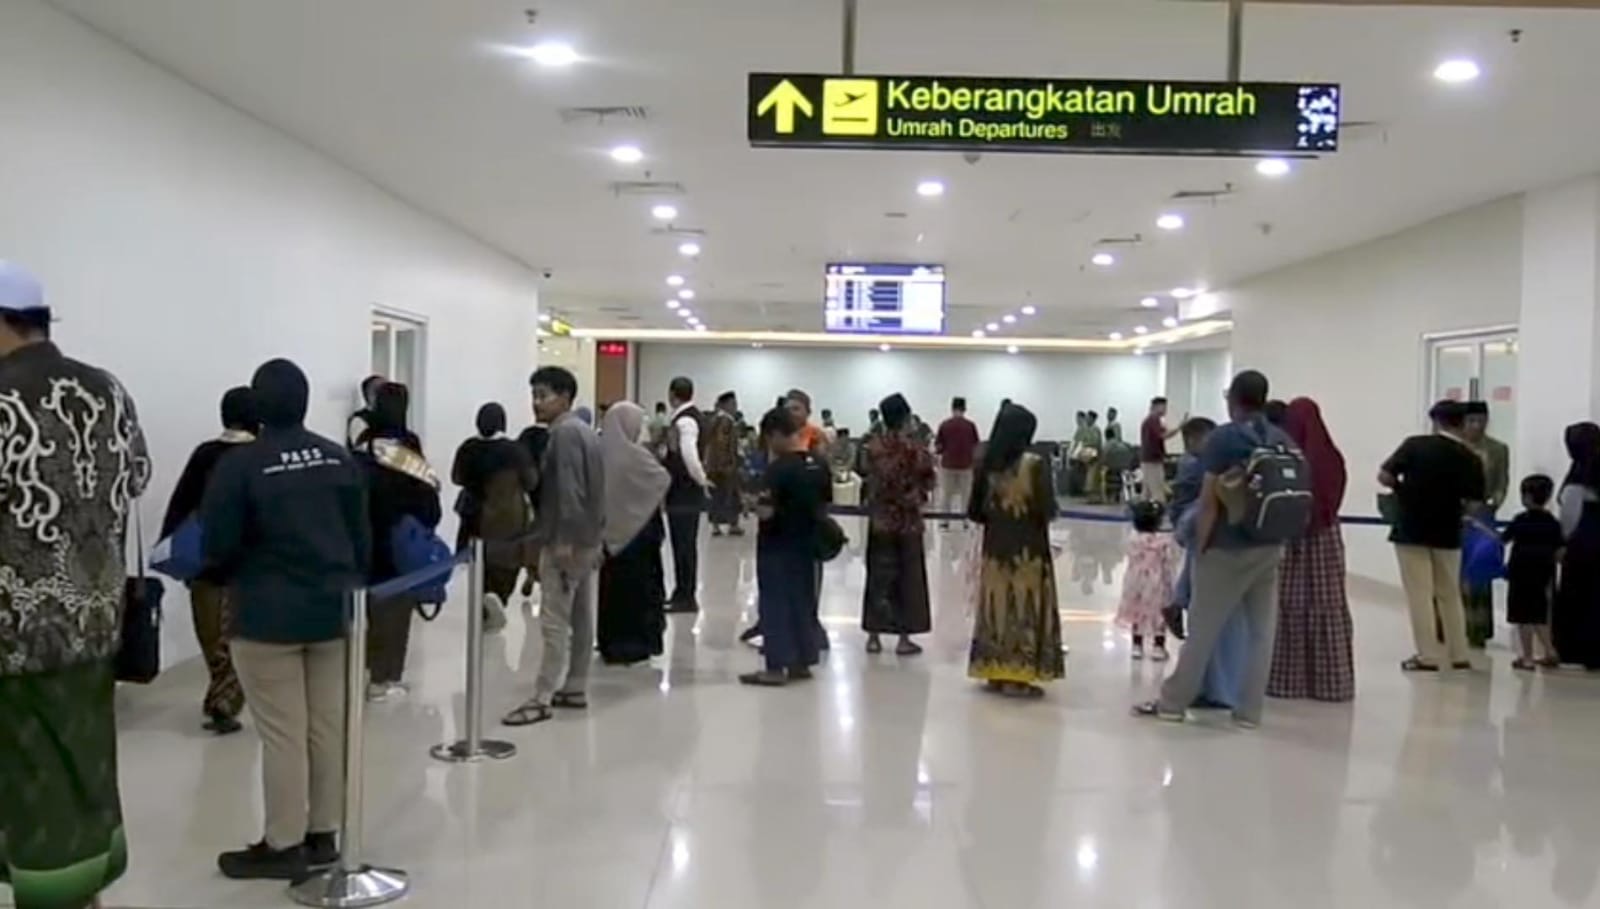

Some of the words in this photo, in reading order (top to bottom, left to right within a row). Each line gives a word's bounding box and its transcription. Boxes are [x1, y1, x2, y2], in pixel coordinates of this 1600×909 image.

[887, 79, 1135, 119] Keberangkatan
[1147, 84, 1256, 115] Umrah
[887, 117, 953, 137] Umrah
[959, 118, 1068, 141] Departures
[281, 448, 322, 463] PASS
